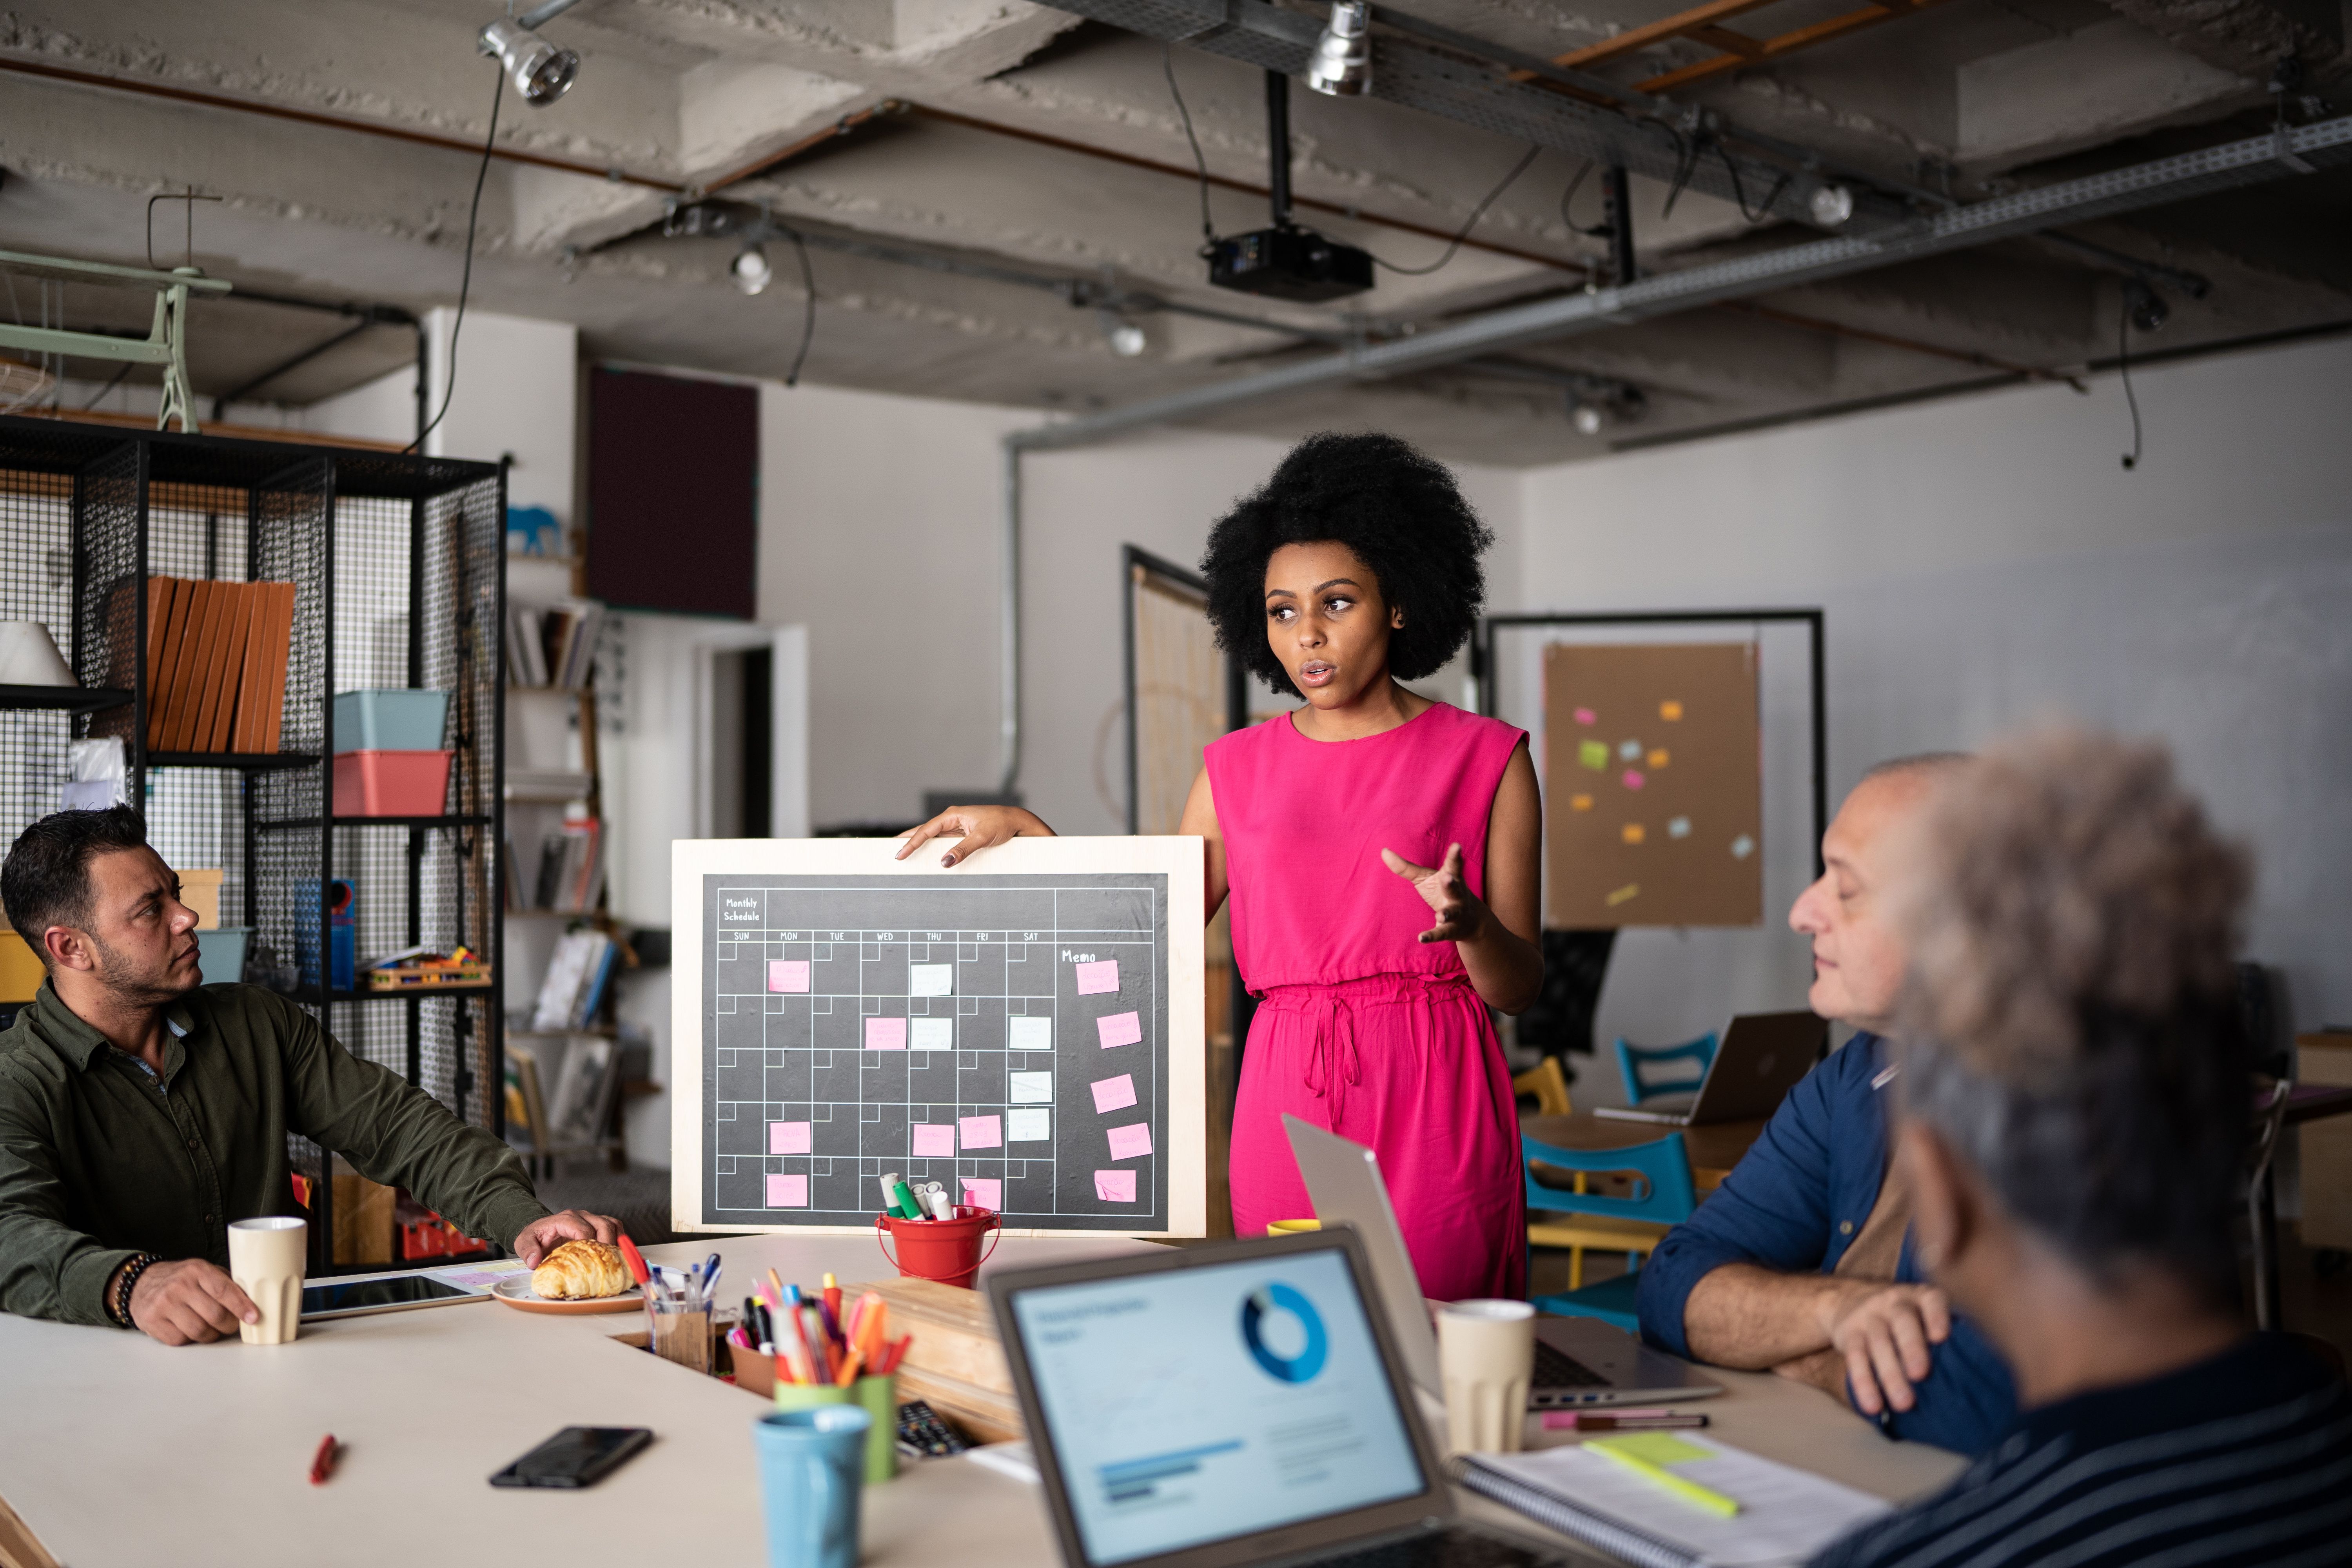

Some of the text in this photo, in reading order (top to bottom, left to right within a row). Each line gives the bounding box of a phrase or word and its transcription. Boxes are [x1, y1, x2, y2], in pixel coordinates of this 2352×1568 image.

[726, 897, 757, 908] Monthly
[724, 911, 759, 921] Schedule
[780, 932, 798, 940] MON
[830, 933, 844, 941] TUE
[877, 933, 894, 941] WED
[926, 933, 941, 941] THU
[1062, 950, 1096, 963] Memo
